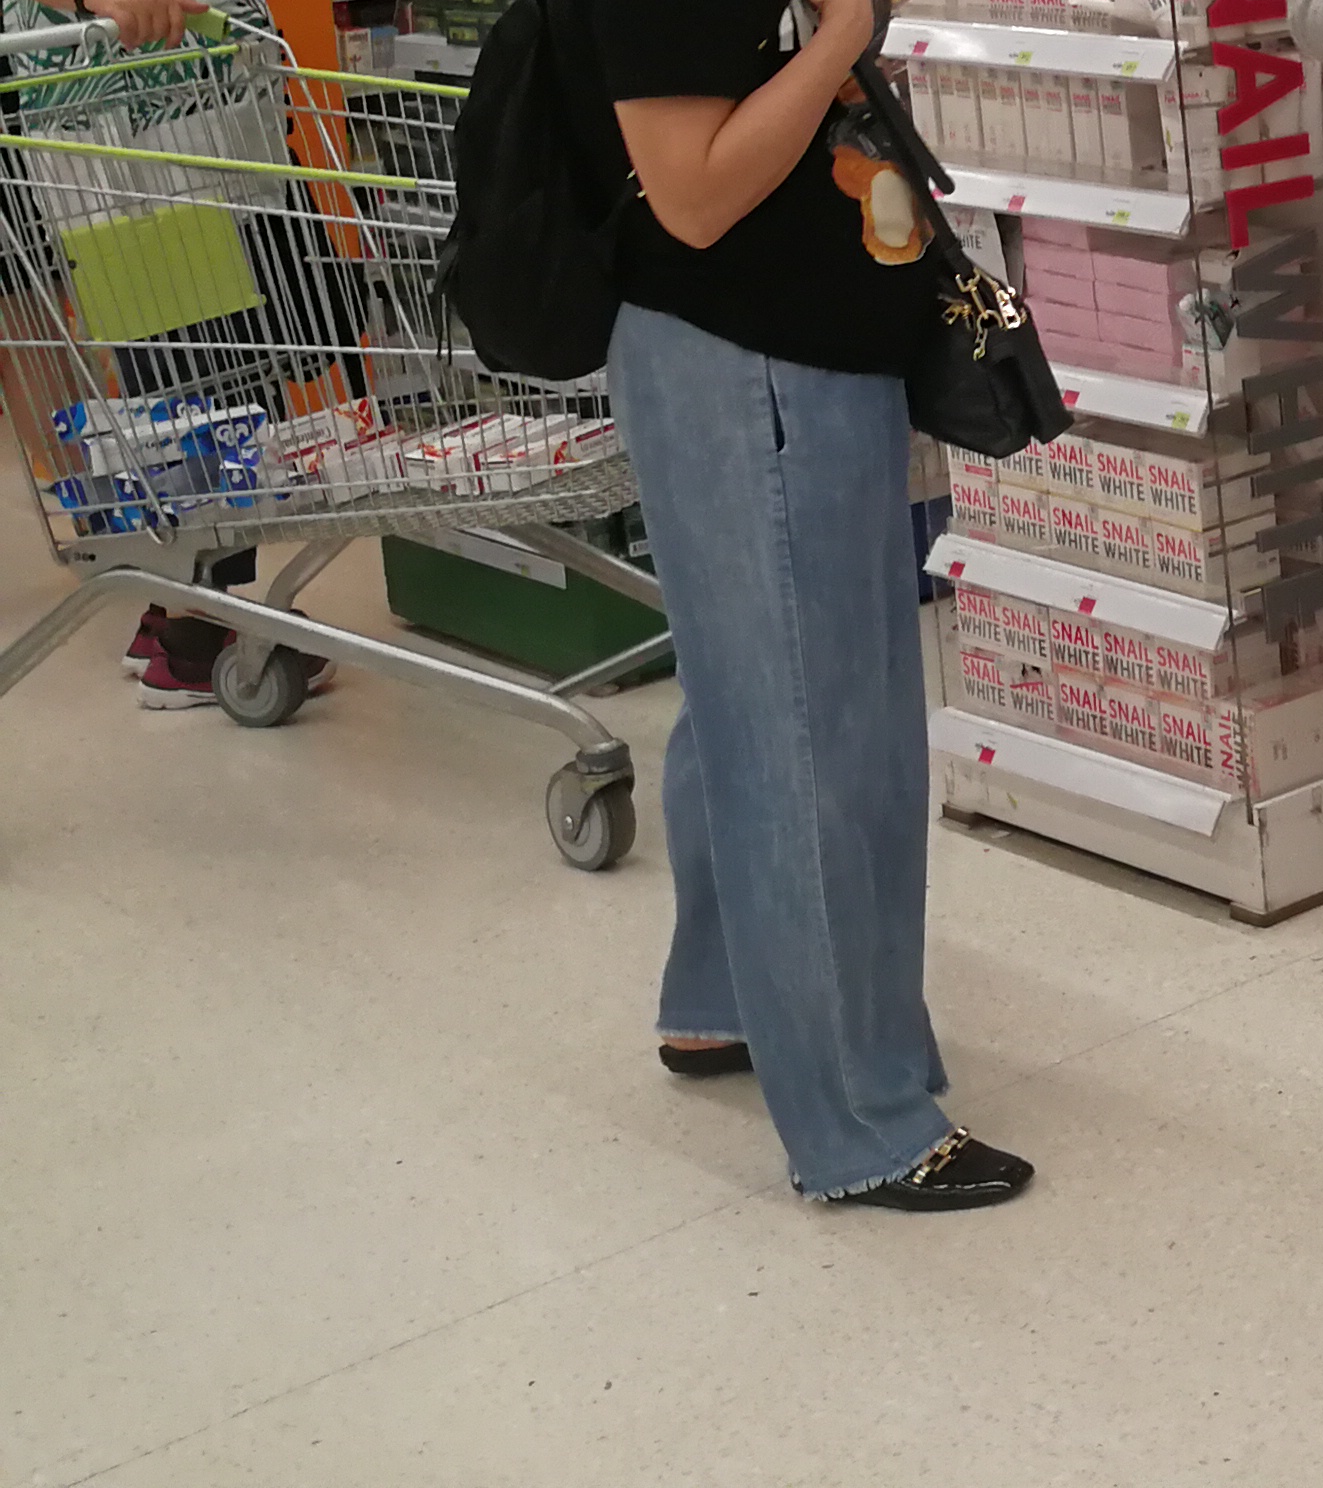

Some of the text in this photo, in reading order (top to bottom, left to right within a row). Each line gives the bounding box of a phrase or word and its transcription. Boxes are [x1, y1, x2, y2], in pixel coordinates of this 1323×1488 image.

[1050, 462, 1197, 515] WHITE WHITE WHITE
[1097, 453, 1195, 494] SNAIL SNAIL
[1002, 495, 1201, 563] SNAIL SNAIL SNAIL SNAIL
[1003, 515, 1150, 569] WHITE WHITE WHITE
[958, 614, 1048, 659] WHITE WHITE
[1002, 606, 1099, 650] SNAIL SNAIL
